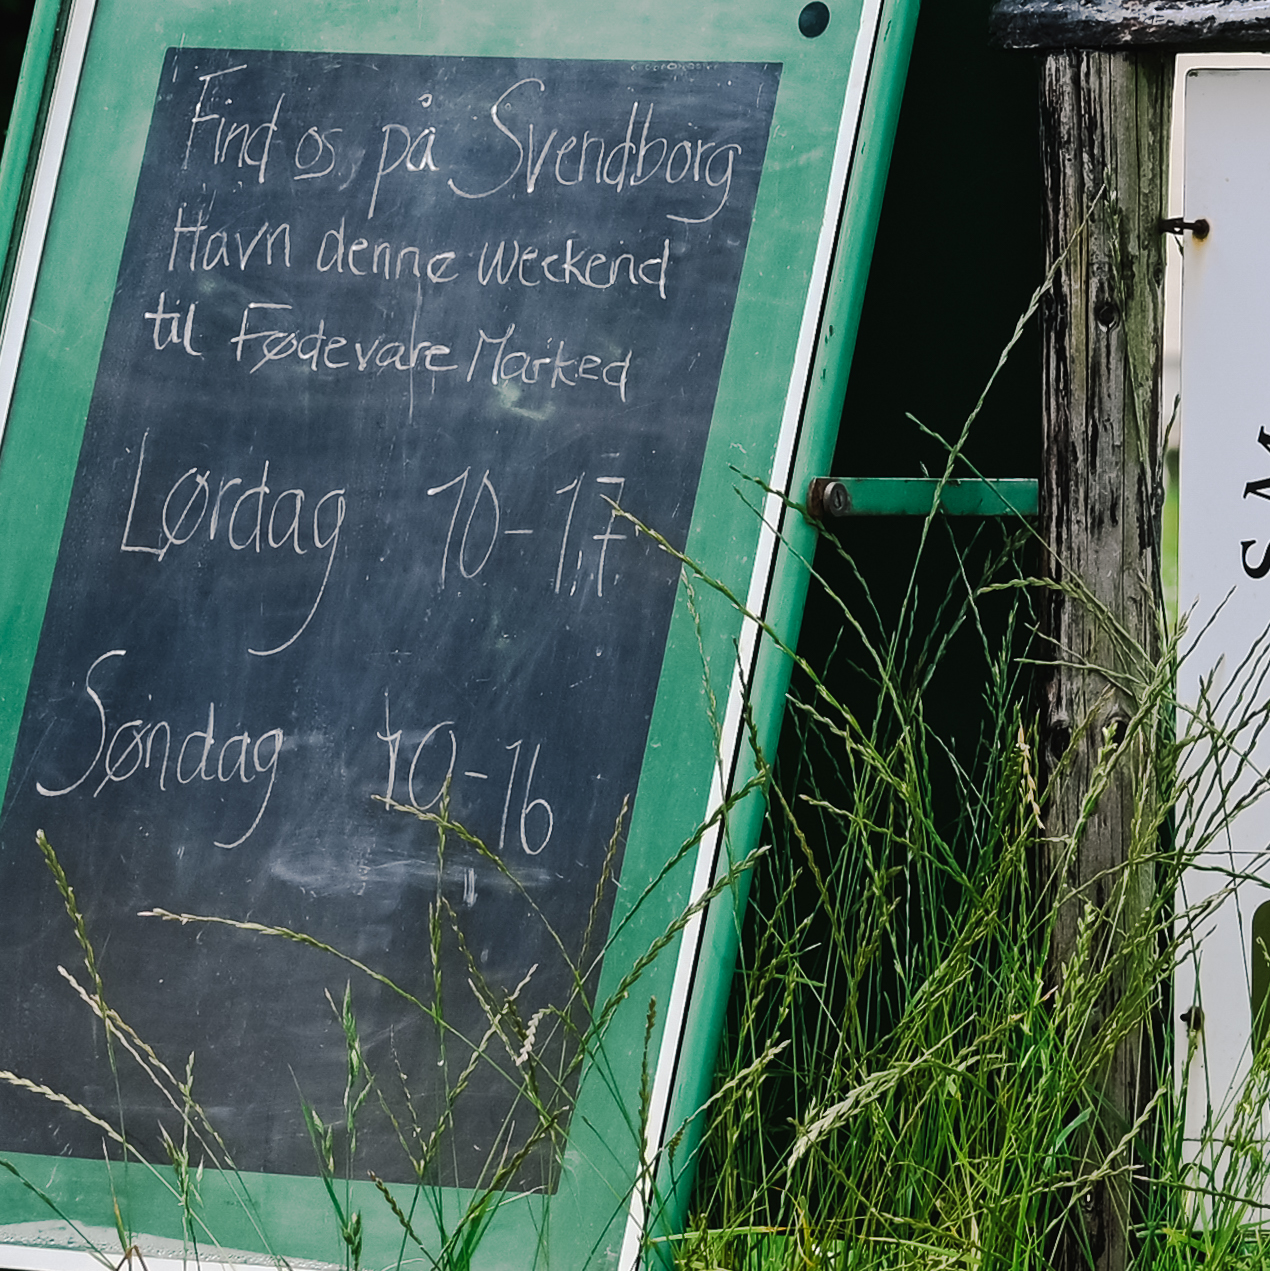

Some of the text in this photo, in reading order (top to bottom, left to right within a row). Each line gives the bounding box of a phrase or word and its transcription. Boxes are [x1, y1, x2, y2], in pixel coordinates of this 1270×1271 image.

[182, 64, 285, 184] Find
[368, 92, 441, 220] på
[448, 77, 743, 224] Svendborg
[144, 292, 203, 357] til
[168, 206, 292, 272] Havn
[317, 218, 459, 283] denne
[120, 427, 626, 656] Lørdag 10-17
[36, 649, 554, 856] Søndag 10-16
